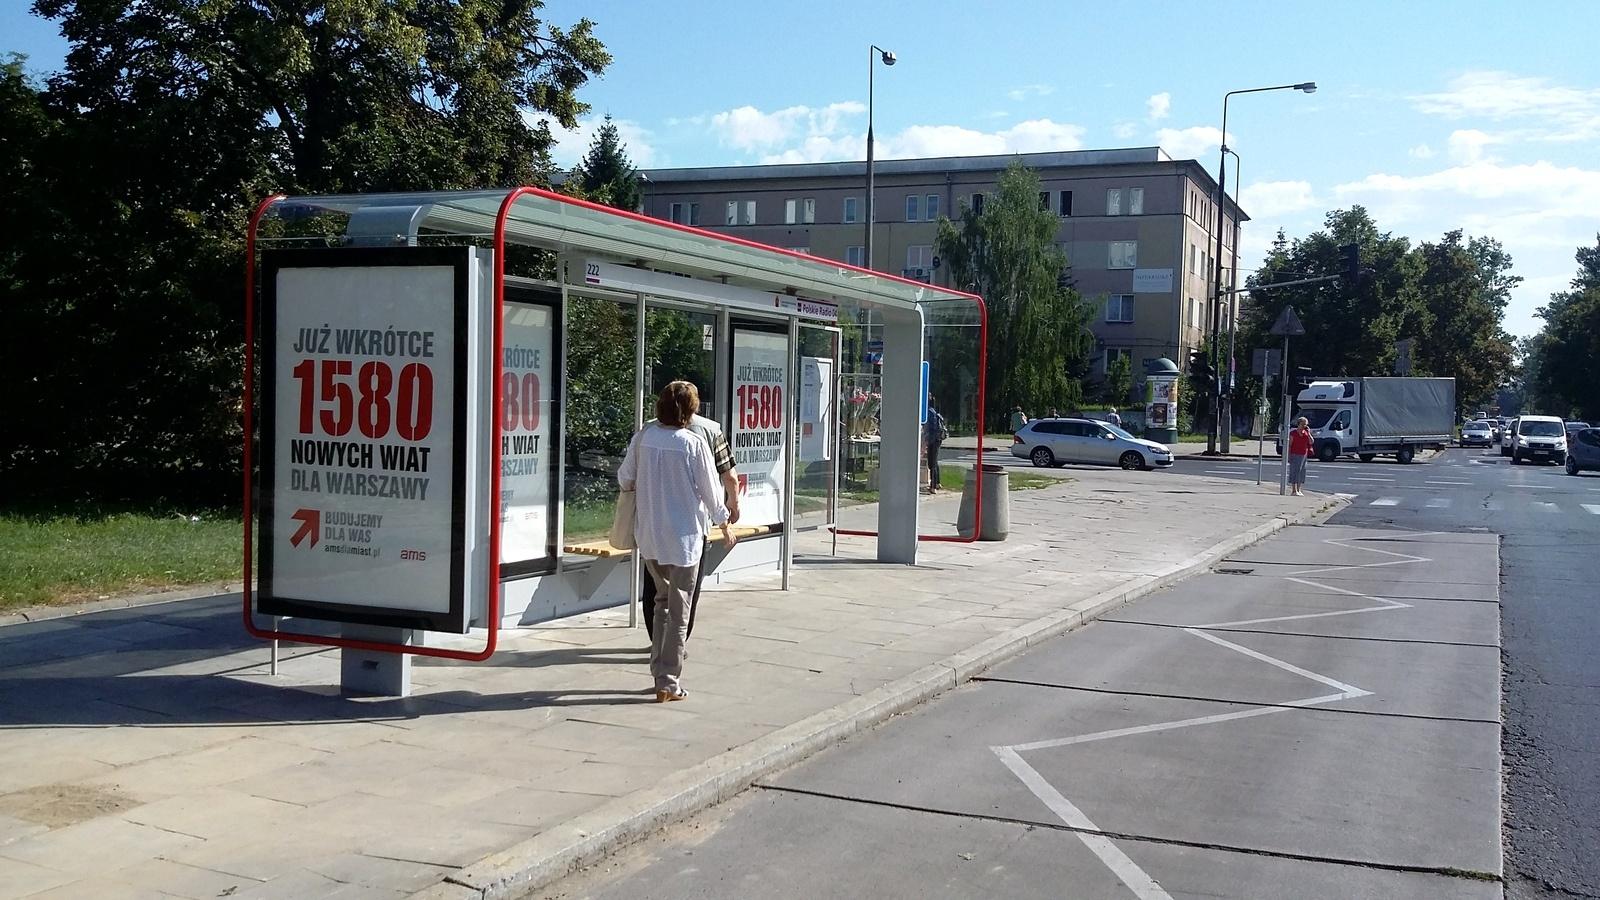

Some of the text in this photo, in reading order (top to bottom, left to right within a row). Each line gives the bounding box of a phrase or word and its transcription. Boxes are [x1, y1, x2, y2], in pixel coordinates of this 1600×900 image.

[587, 263, 600, 276] 222
[802, 303, 819, 315] Polskie
[819, 307, 832, 317] Radio
[293, 324, 434, 357] JUŻ WKRÓTCE
[502, 344, 540, 368] RÓTCE
[738, 364, 782, 383] JUŻ WKRÓTCE
[293, 359, 434, 441] 1580
[502, 372, 540, 432] 80
[737, 385, 782, 430] 1580
[513, 435, 540, 454] WIAT
[736, 432, 781, 448] NOWYCH WIAT
[291, 439, 431, 472] NOWYCH WIAT
[736, 449, 781, 464] DLA WARSZAWY
[501, 458, 538, 476] RSZAWY
[291, 469, 430, 501] DLA WARSZAWY
[325, 512, 383, 528] BUDUJEMY
[325, 527, 372, 543] DLA WAS
[400, 549, 426, 561] ams
